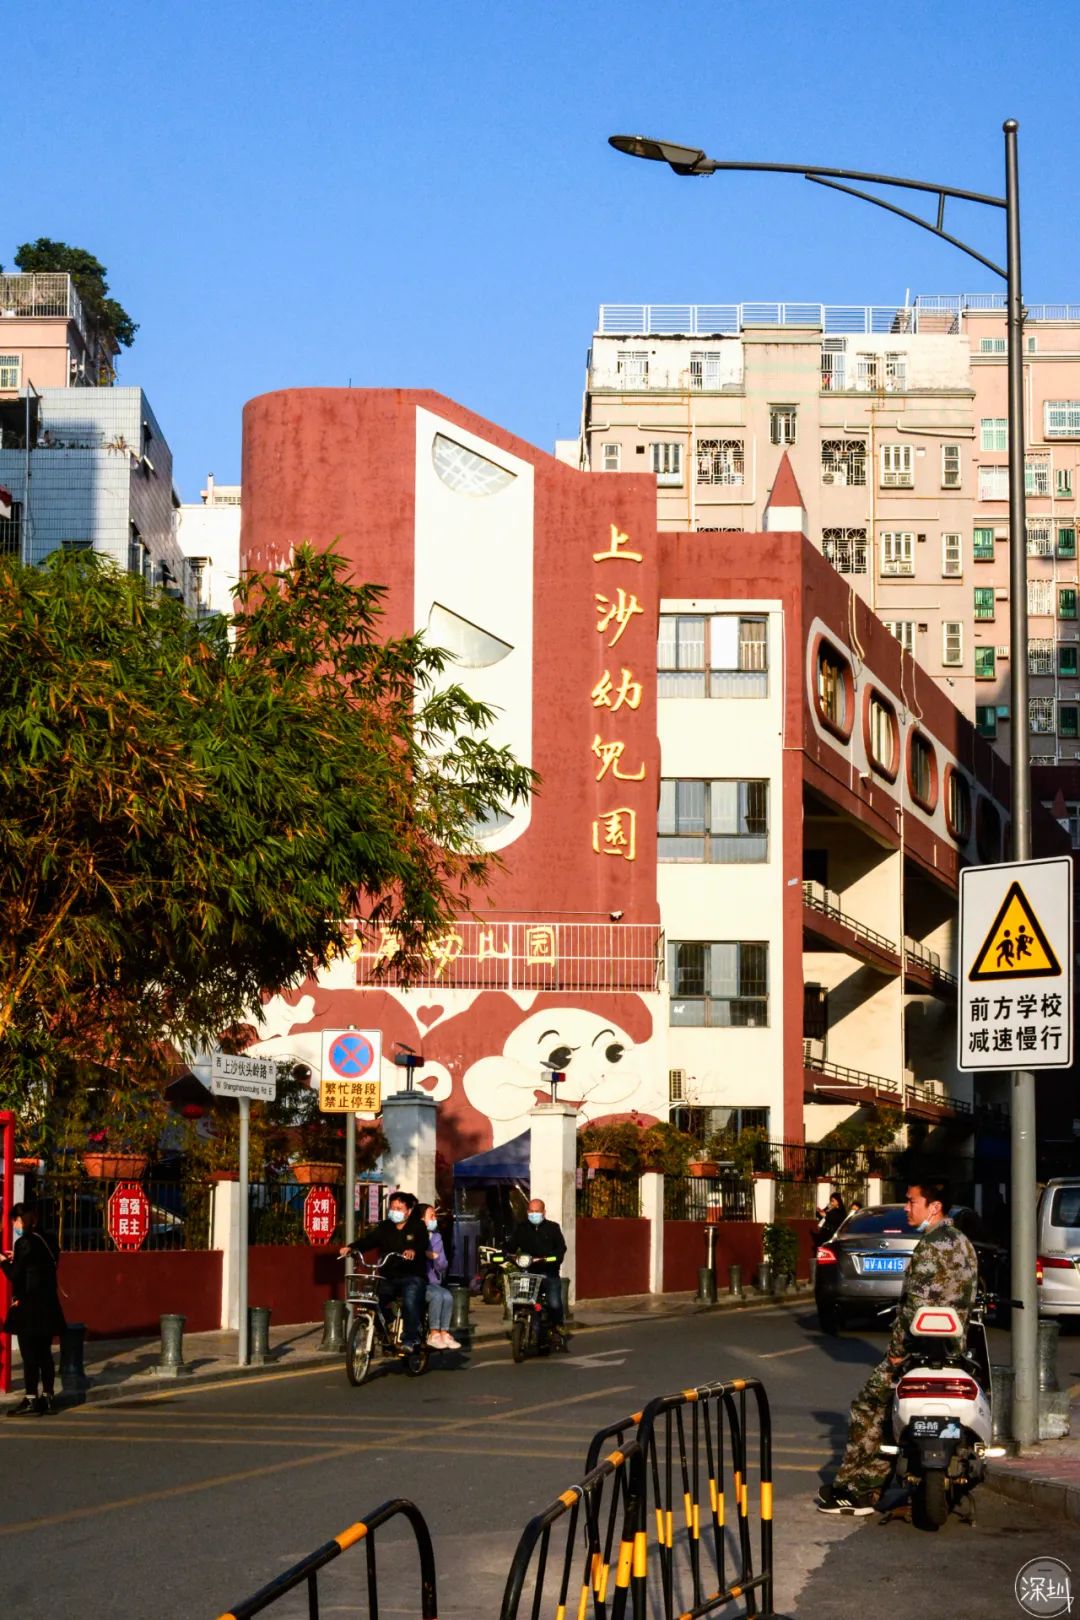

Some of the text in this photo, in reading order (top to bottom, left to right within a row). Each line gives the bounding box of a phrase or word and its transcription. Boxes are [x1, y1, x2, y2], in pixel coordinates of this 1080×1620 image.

[970, 993, 1062, 1022] 前方学校
[969, 1025, 1062, 1053] 减速慢行
[325, 1082, 376, 1095] 繁忙路段
[324, 1096, 376, 1108] 禁止停车
[119, 1197, 140, 1215] 富强
[312, 1199, 330, 1214] 文明
[119, 1218, 140, 1235] 民主
[312, 1216, 329, 1231] 和谐
